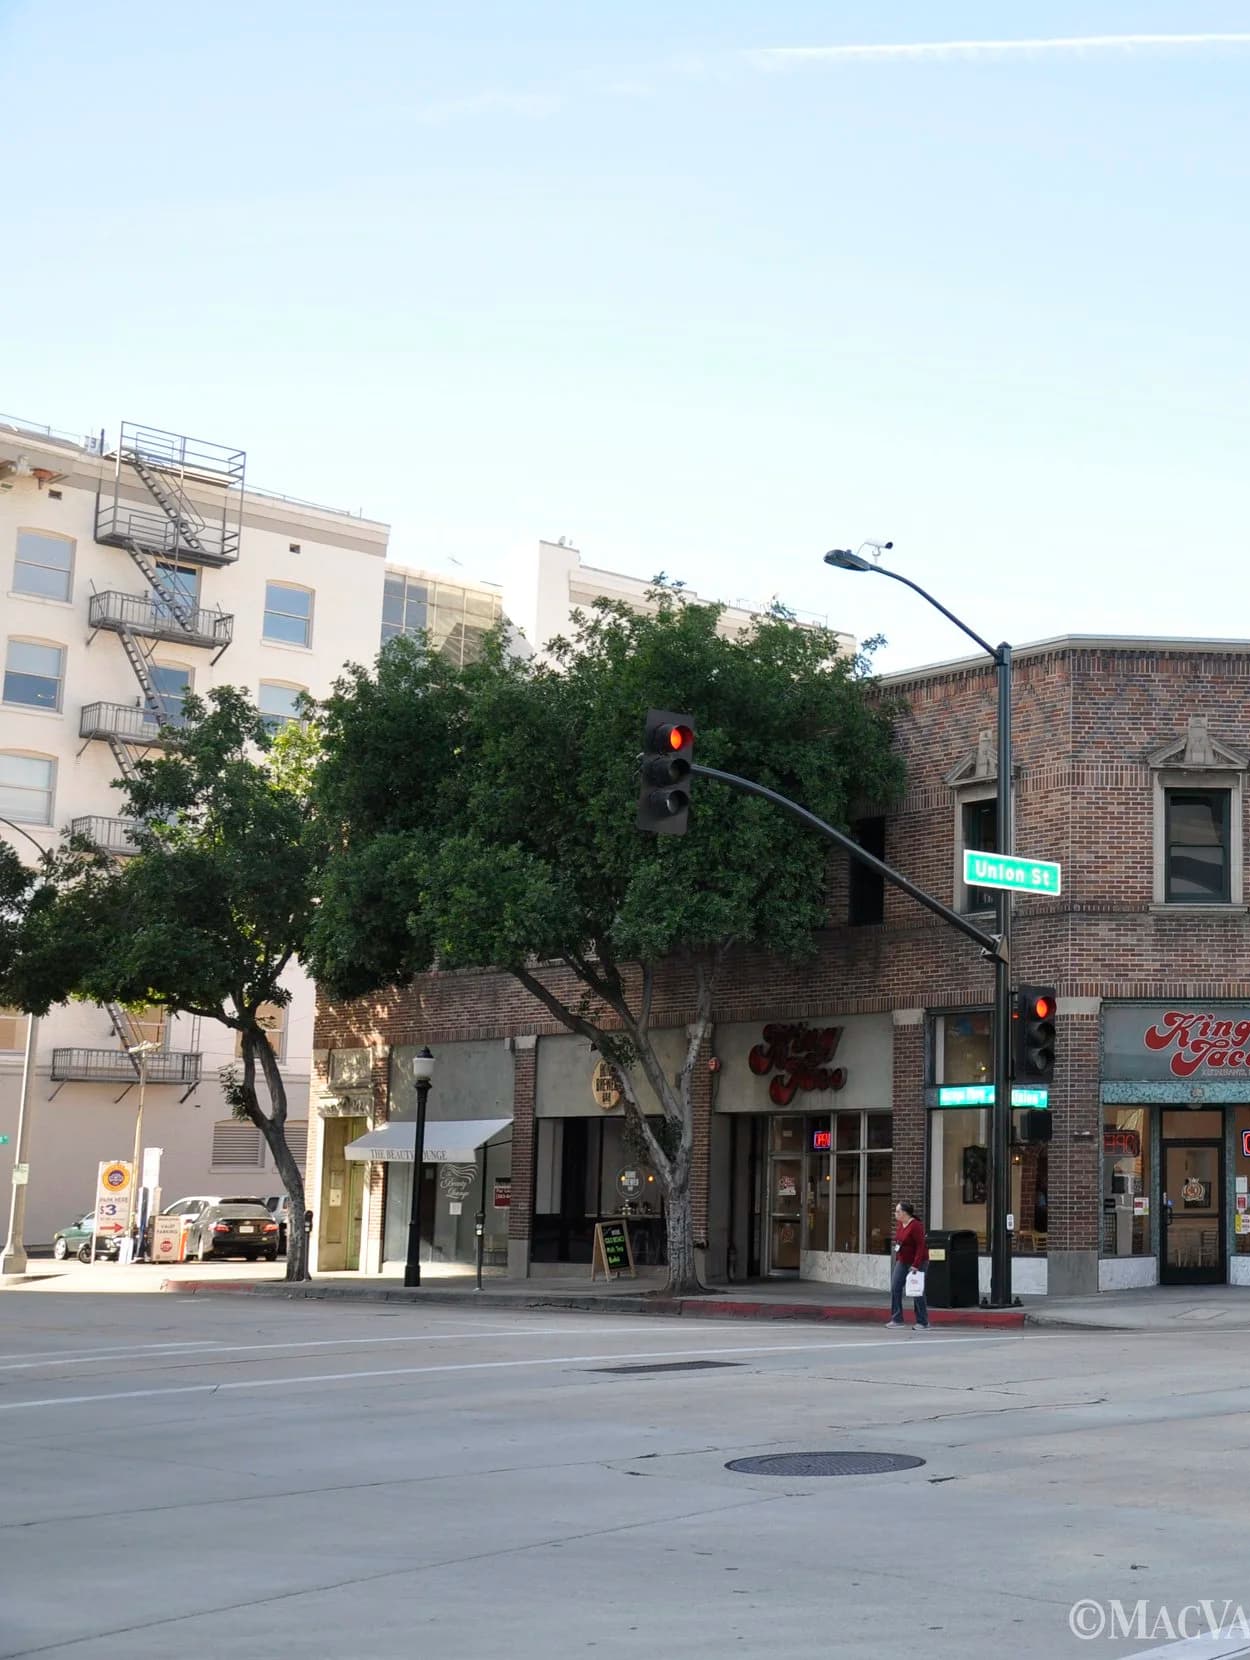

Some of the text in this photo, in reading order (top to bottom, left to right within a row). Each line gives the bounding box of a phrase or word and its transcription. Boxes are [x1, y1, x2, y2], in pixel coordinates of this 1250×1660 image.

[975, 859, 1051, 887] Union St
[749, 1022, 845, 1076] King
[371, 1149, 386, 1160] THE
[387, 1149, 416, 1161] BEAUTY
[100, 1204, 117, 1216] $3
